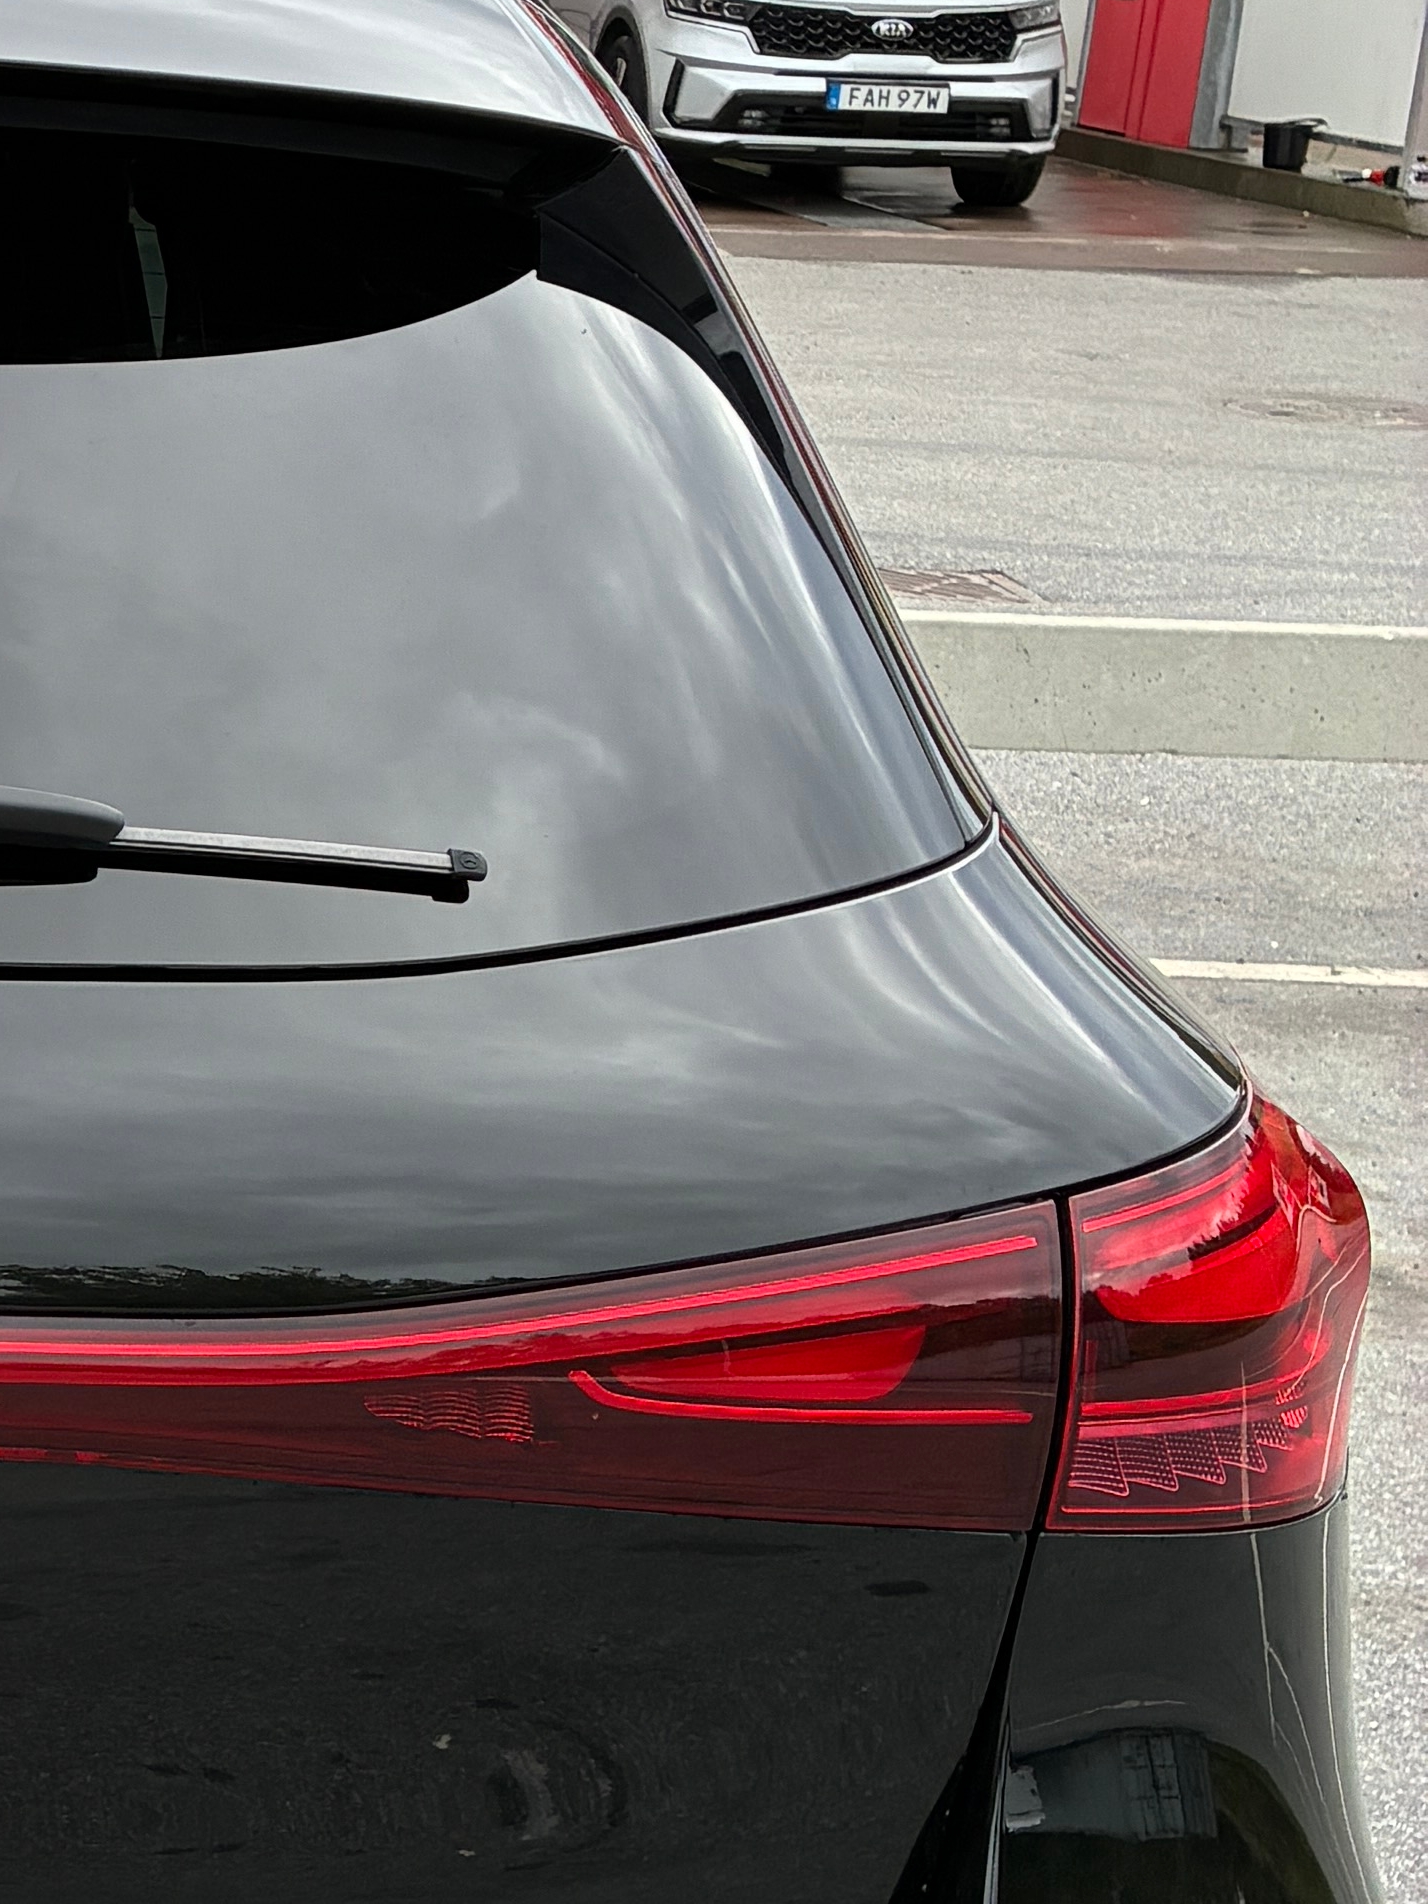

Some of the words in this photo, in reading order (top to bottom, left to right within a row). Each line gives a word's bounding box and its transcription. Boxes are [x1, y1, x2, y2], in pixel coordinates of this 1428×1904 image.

[878, 21, 908, 38] KIA
[848, 87, 891, 108] FAH
[898, 89, 941, 110] 97W
